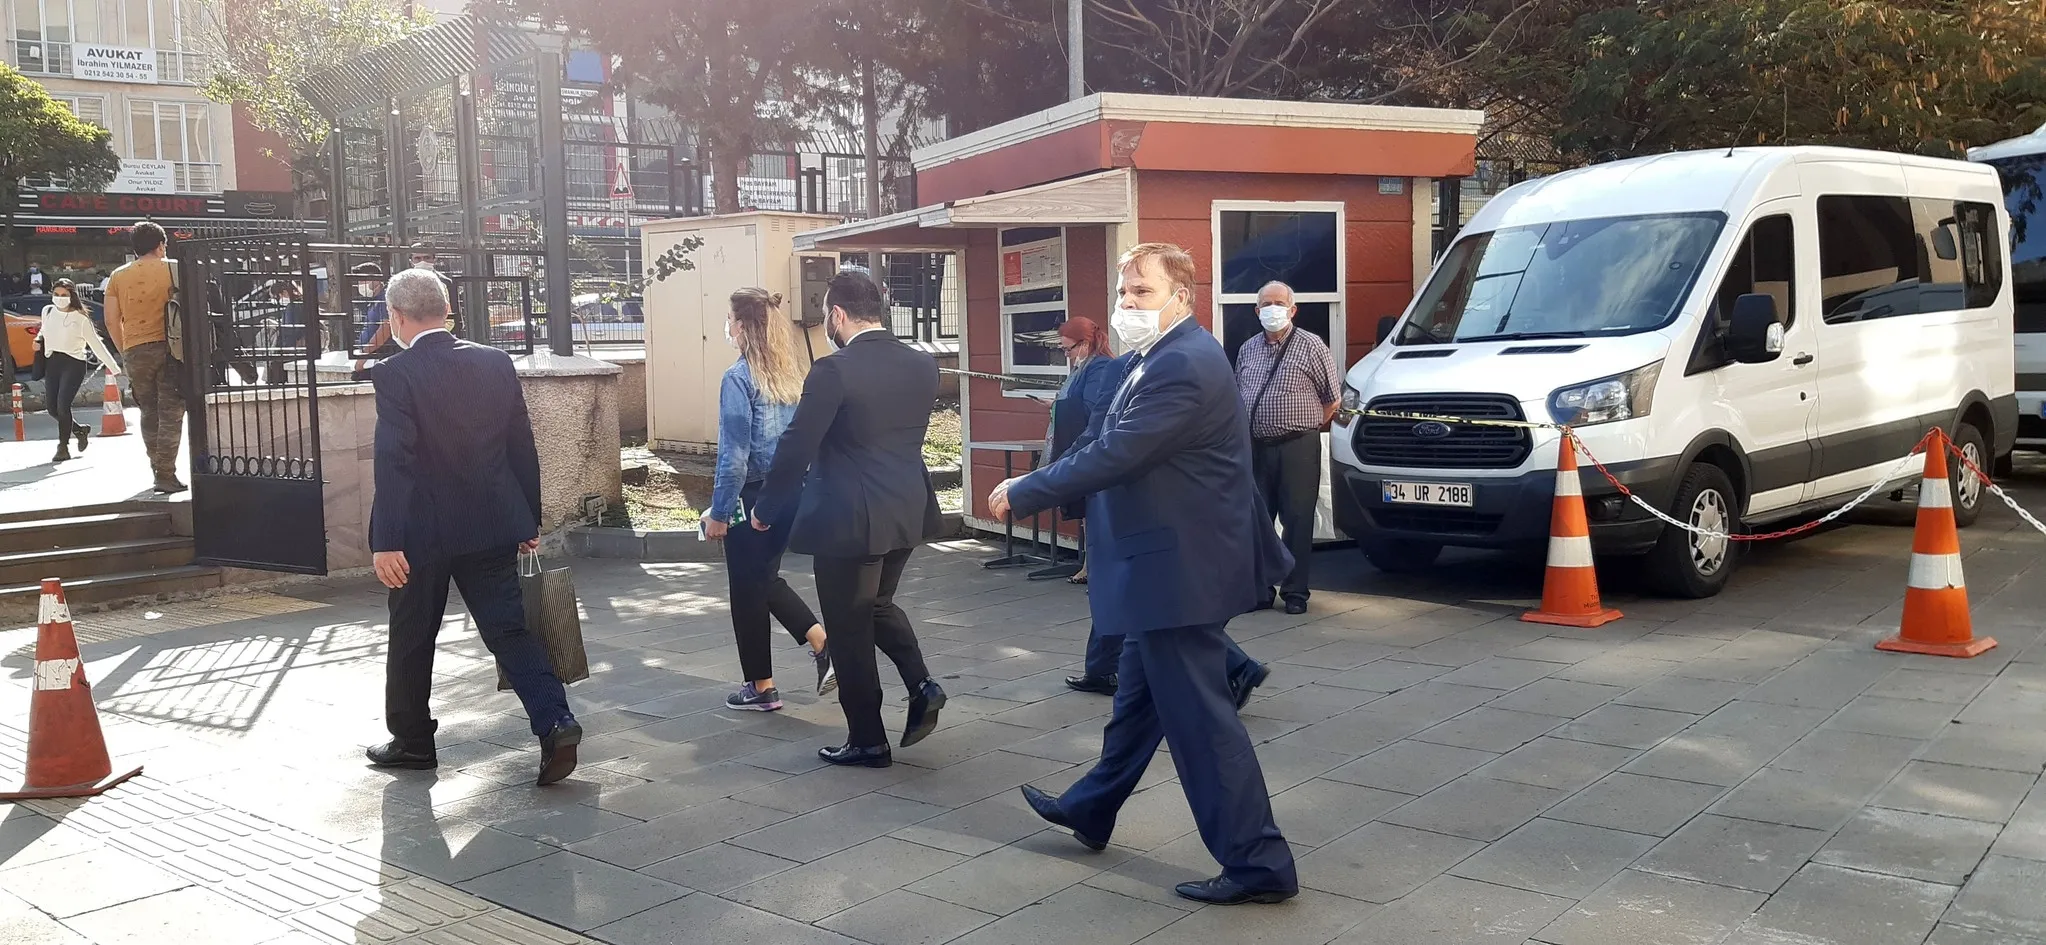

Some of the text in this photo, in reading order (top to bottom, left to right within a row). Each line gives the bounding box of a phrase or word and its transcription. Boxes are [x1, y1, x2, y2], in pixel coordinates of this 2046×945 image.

[87, 48, 143, 60] AVUKAT
[77, 57, 153, 71] İbrahim YILMAZER
[84, 69, 100, 77] 0212
[119, 196, 205, 214] COURT
[35, 226, 77, 234] HAMBURGER
[1418, 423, 1441, 436] Ford
[1391, 484, 1406, 500] 34
[1414, 485, 1430, 501] UR
[1438, 486, 1468, 503] 2188
